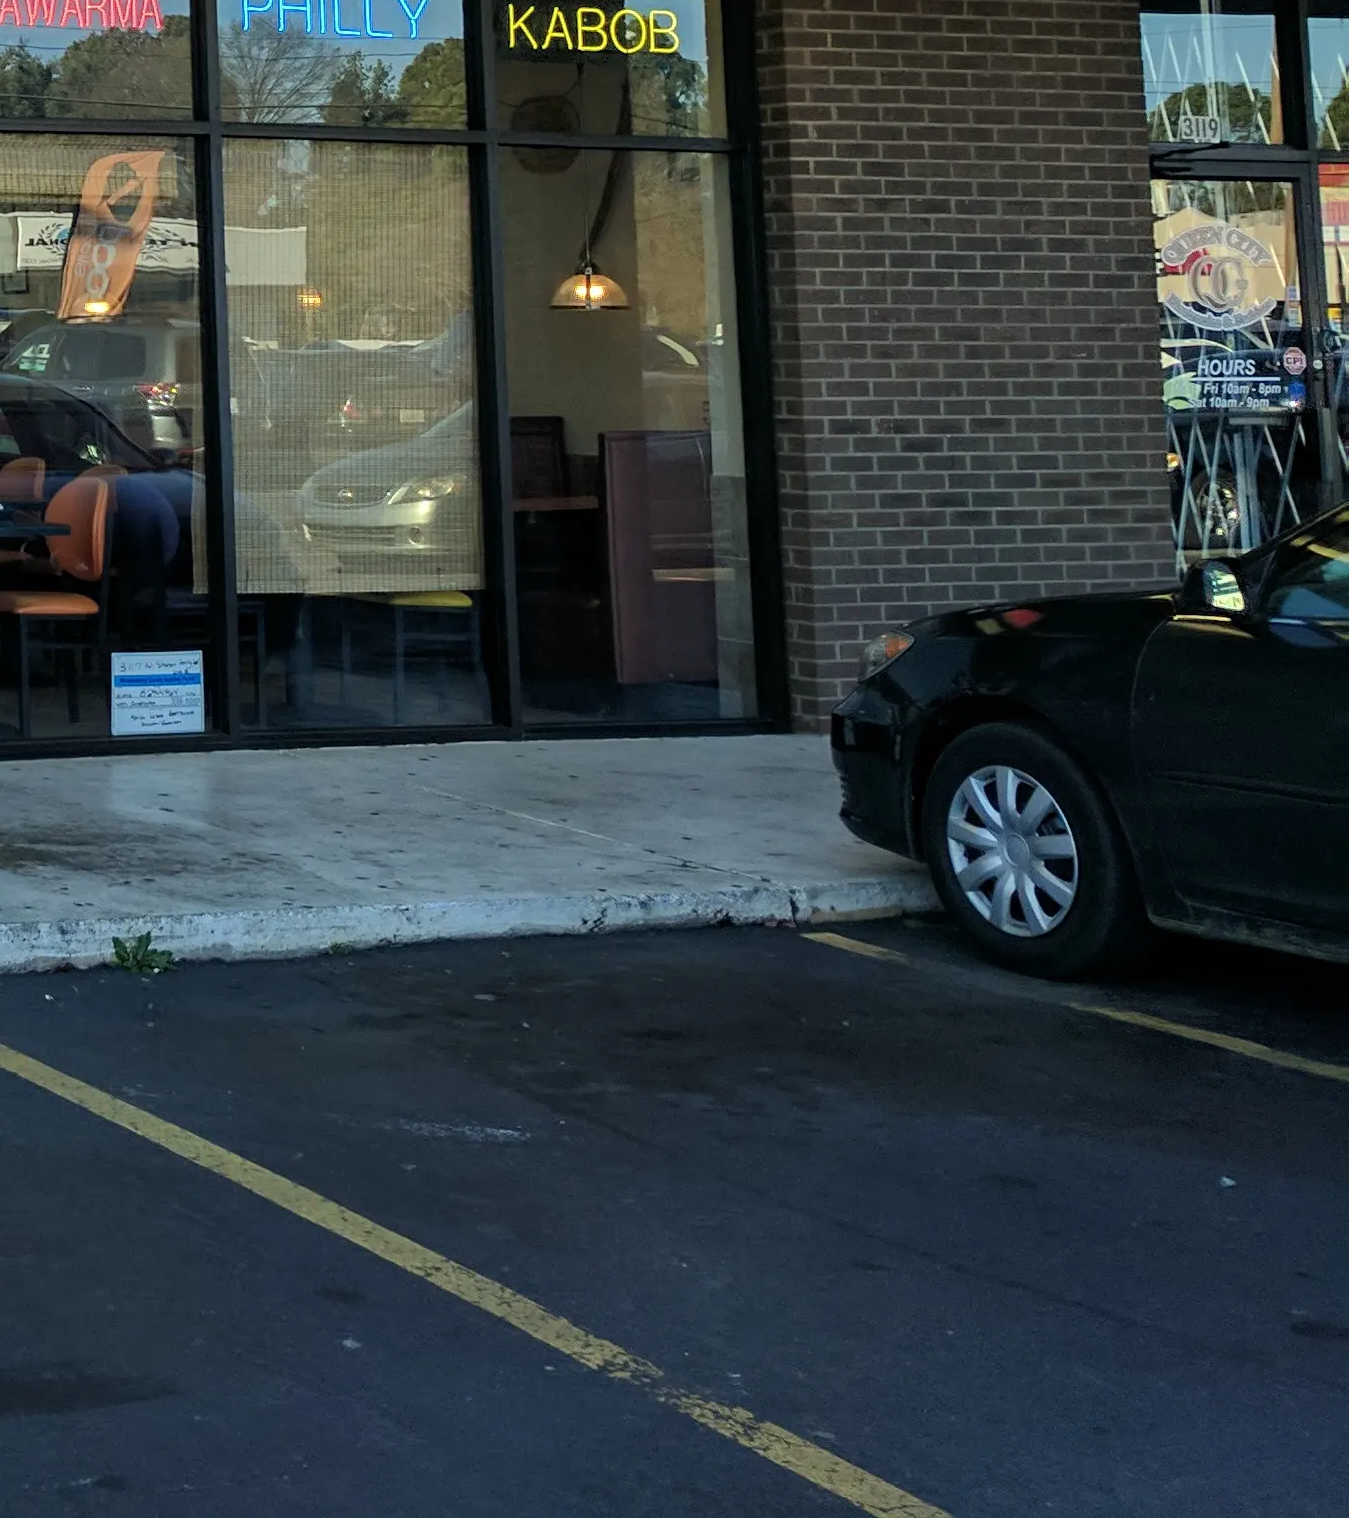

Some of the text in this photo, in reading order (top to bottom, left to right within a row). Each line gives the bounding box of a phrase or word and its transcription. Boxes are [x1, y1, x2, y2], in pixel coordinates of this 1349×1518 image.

[507, 3, 680, 55] KABOB
[1182, 117, 1219, 139] 3119
[1197, 359, 1256, 376] HOURS
[1203, 384, 1219, 394] Fri
[1221, 384, 1250, 394] 10am
[1258, 384, 1282, 397] 8pm
[1189, 398, 1206, 407] Sat
[1209, 398, 1239, 407] 10am
[1246, 398, 1270, 409] 9pm
